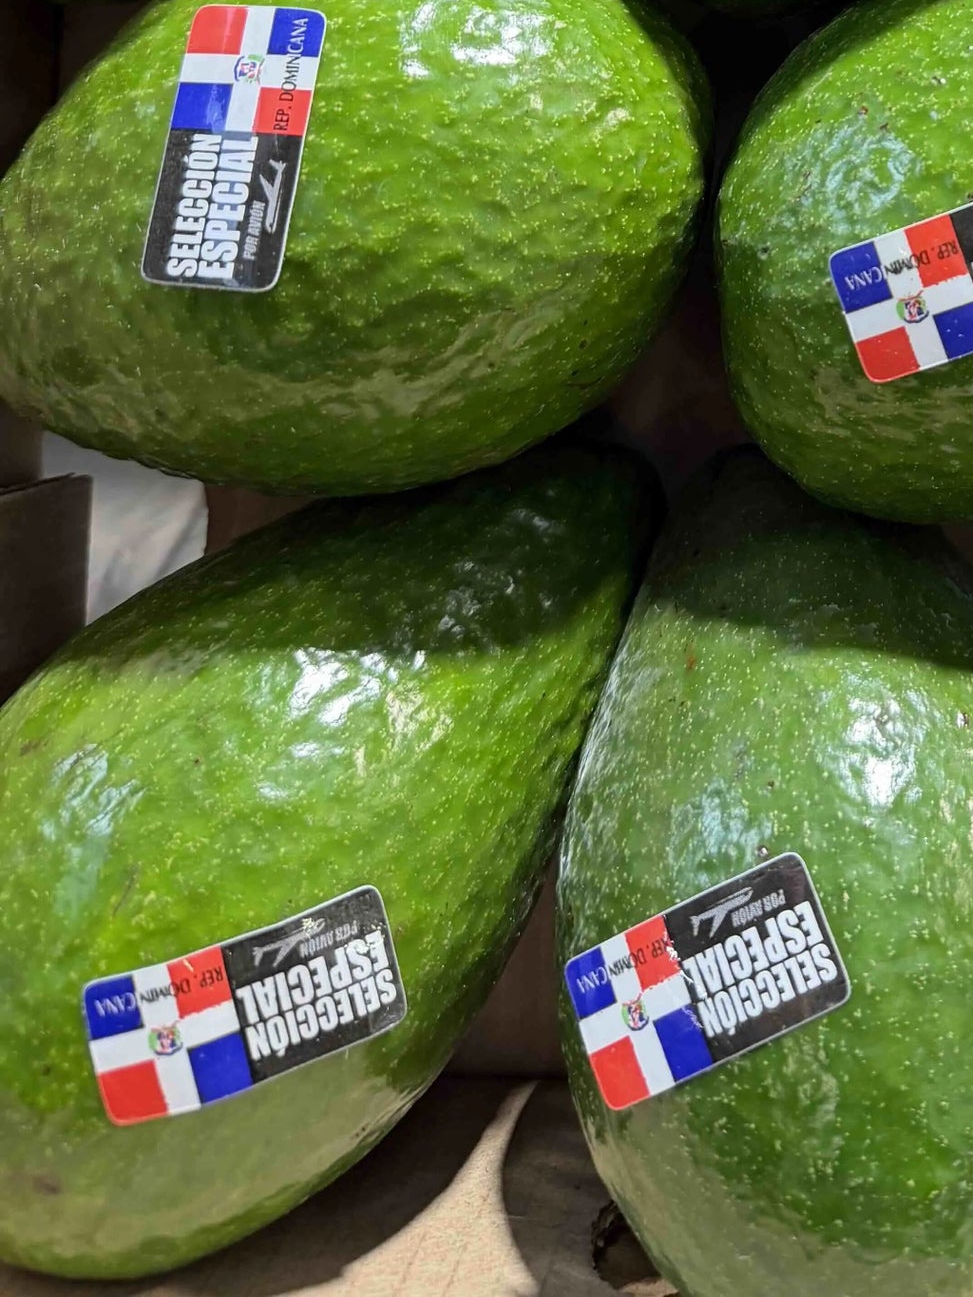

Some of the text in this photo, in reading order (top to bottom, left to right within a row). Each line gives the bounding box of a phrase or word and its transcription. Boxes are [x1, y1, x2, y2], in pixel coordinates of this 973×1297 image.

[274, 18, 309, 131] REP. DOMINICANA
[166, 134, 222, 278] SELECCIÓN
[200, 136, 258, 279] ESPECIAL
[243, 239, 259, 260] POR
[845, 240, 959, 291] REP. DOMINICANA
[762, 889, 786, 911] POR
[193, 966, 224, 989] REP.
[235, 930, 389, 1022] ESPECIAL
[682, 901, 824, 998] ESPECIAL
[700, 943, 838, 1038] SELECCIÓN
[245, 969, 397, 1061] SELECCIÓN
